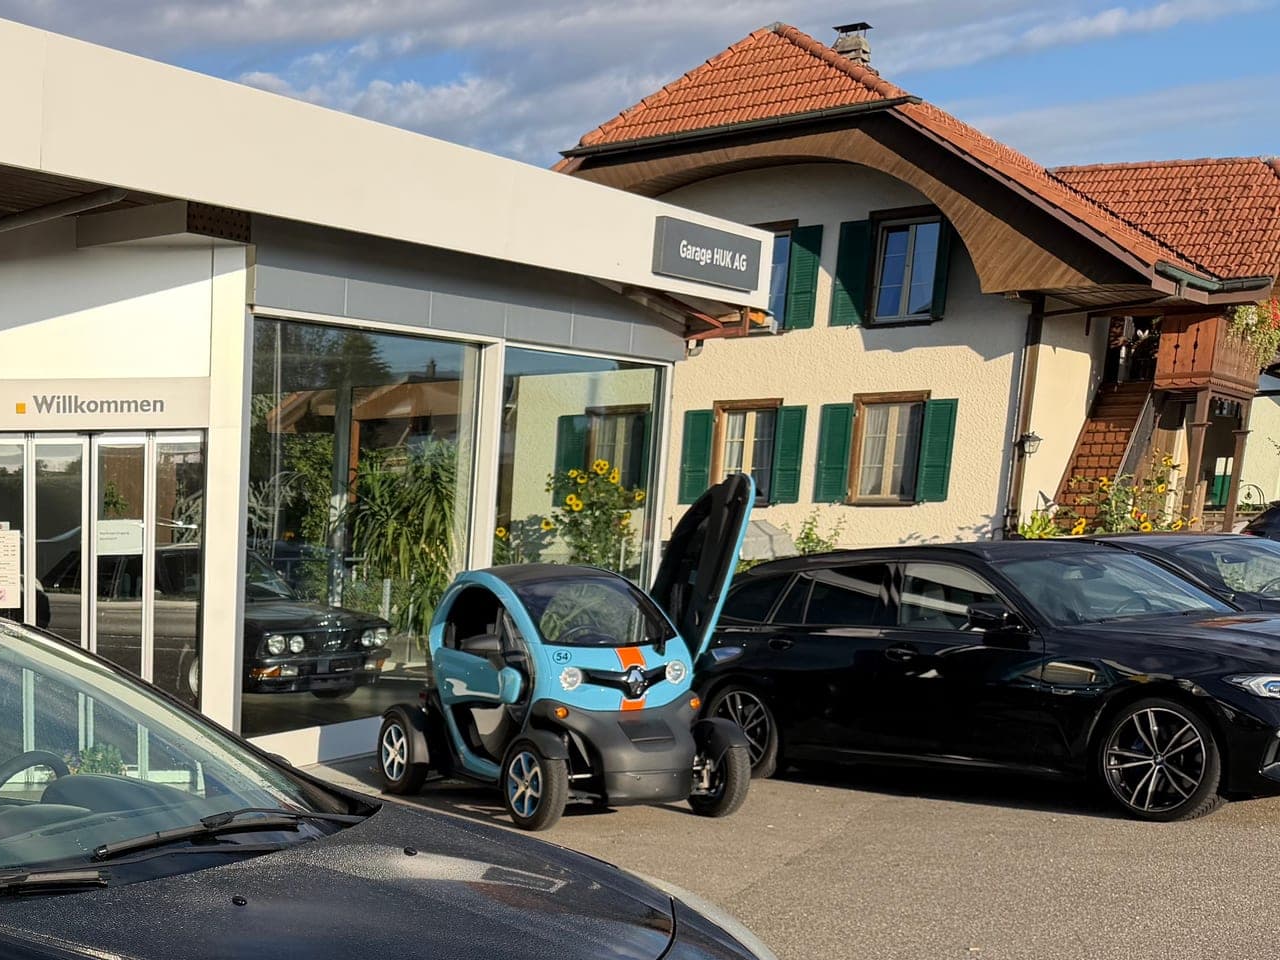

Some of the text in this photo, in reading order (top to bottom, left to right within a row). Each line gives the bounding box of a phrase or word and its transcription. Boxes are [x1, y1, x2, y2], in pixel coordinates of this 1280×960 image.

[679, 239, 747, 271] Garage HUK AG
[32, 395, 164, 414] Willkommen
[556, 652, 568, 661] 54
